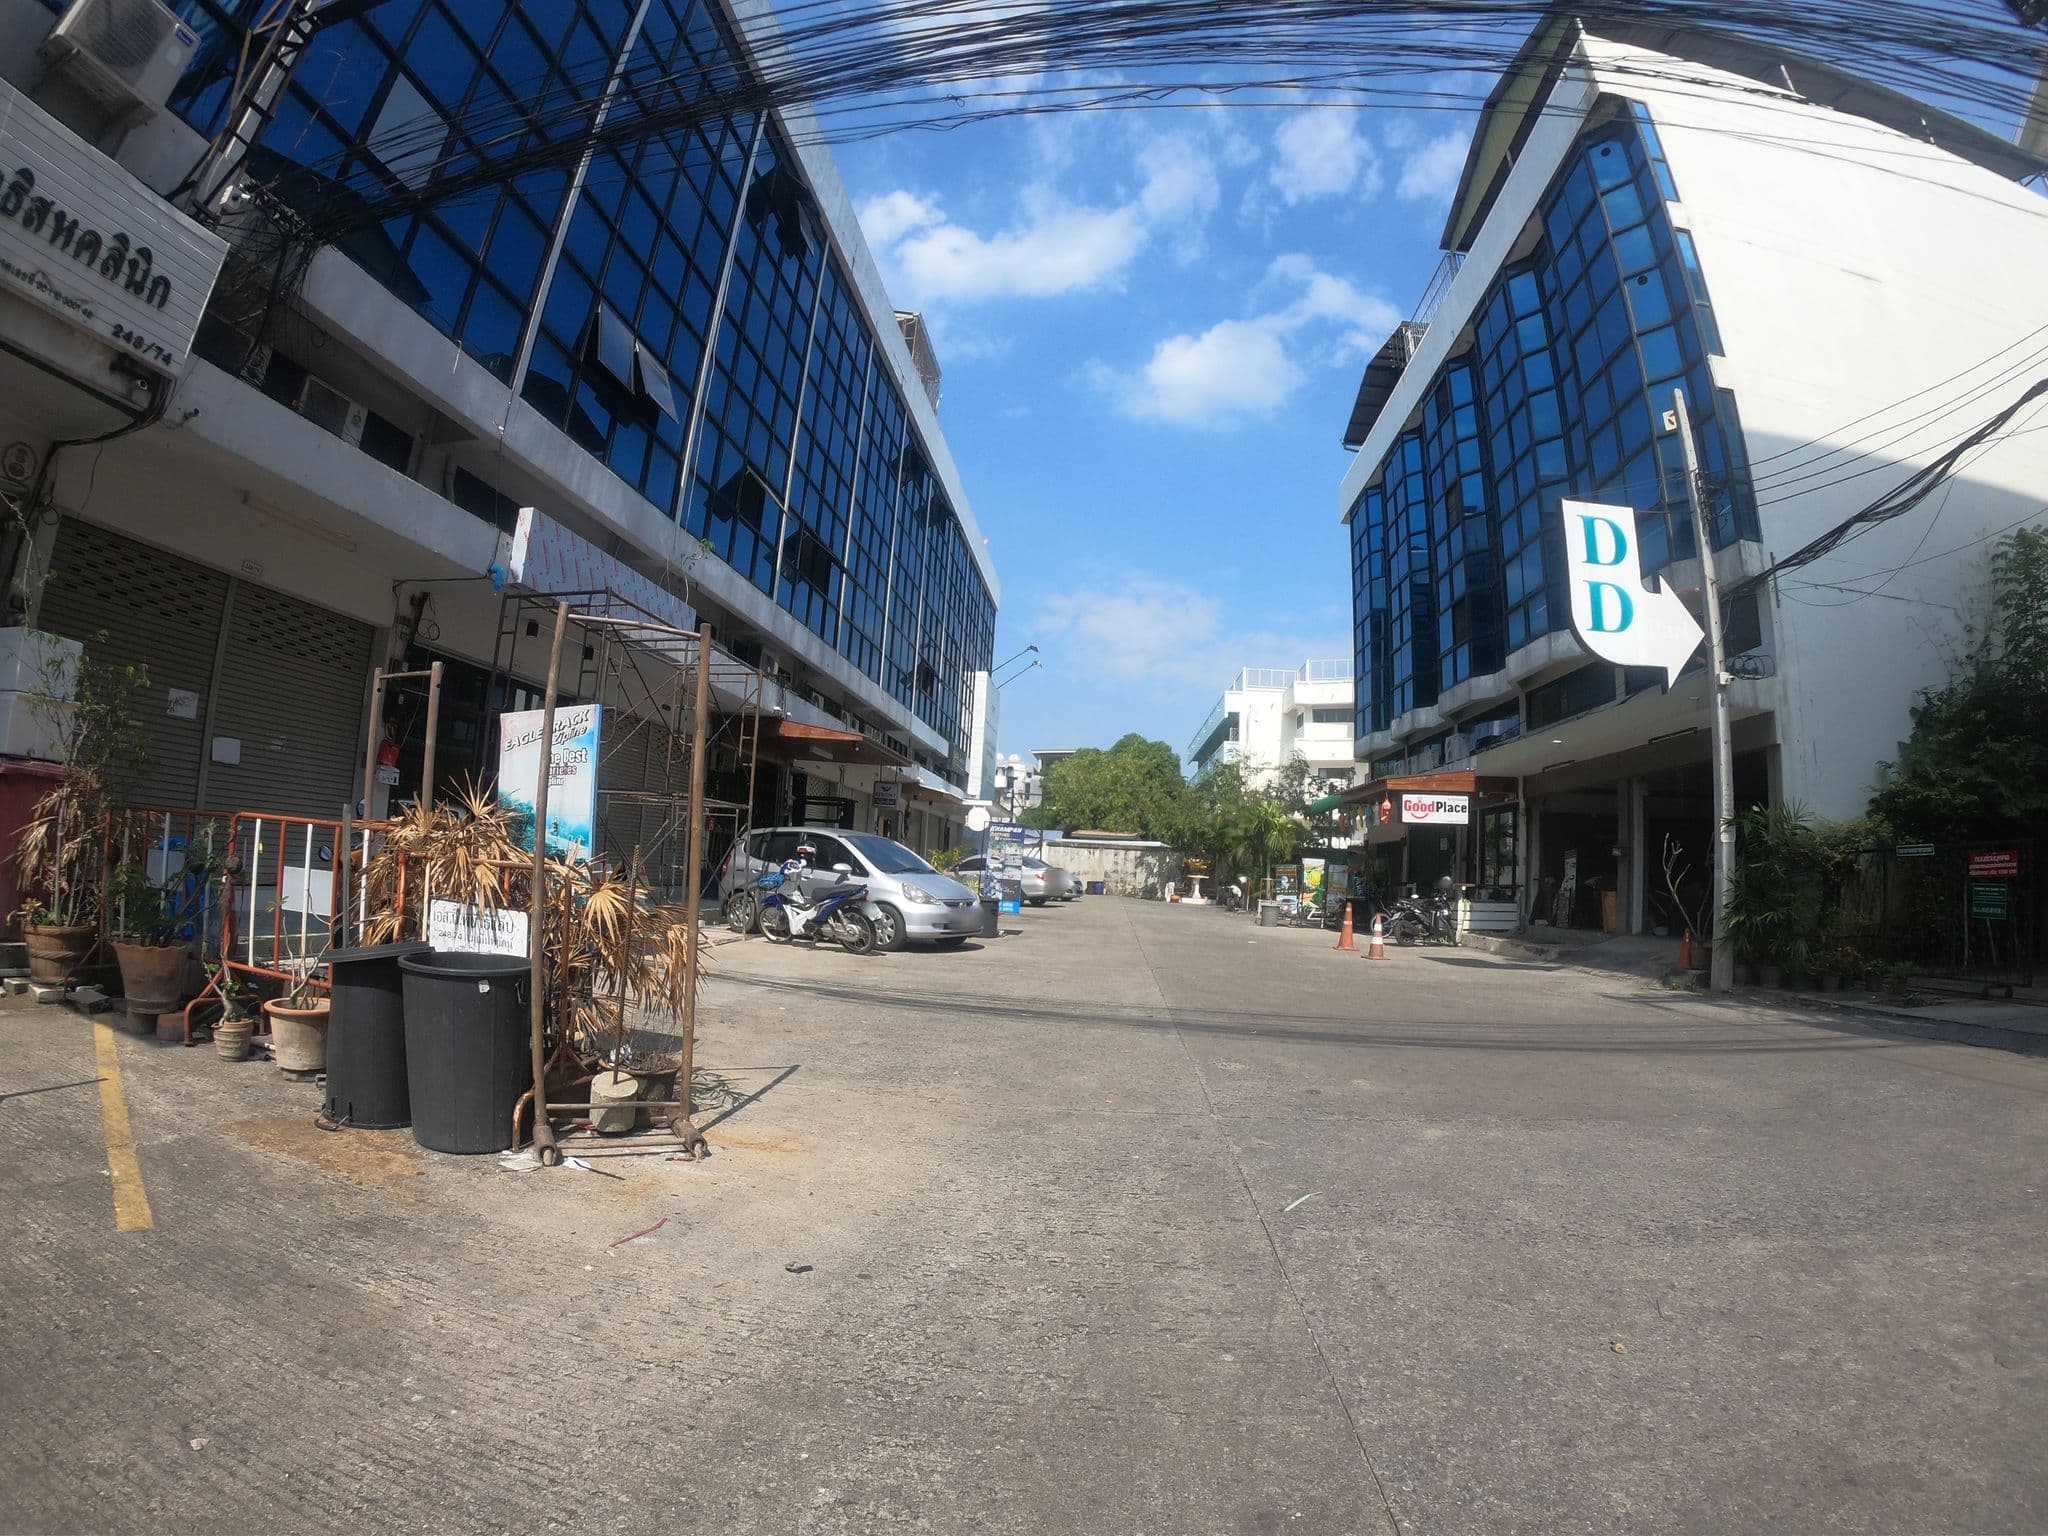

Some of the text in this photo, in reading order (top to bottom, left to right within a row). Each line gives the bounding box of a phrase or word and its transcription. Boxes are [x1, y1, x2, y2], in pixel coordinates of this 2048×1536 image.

[0, 167, 171, 310] ธิสหคลินิก
[504, 709, 590, 752] EAGLE RACK
[552, 726, 588, 746] Zipline
